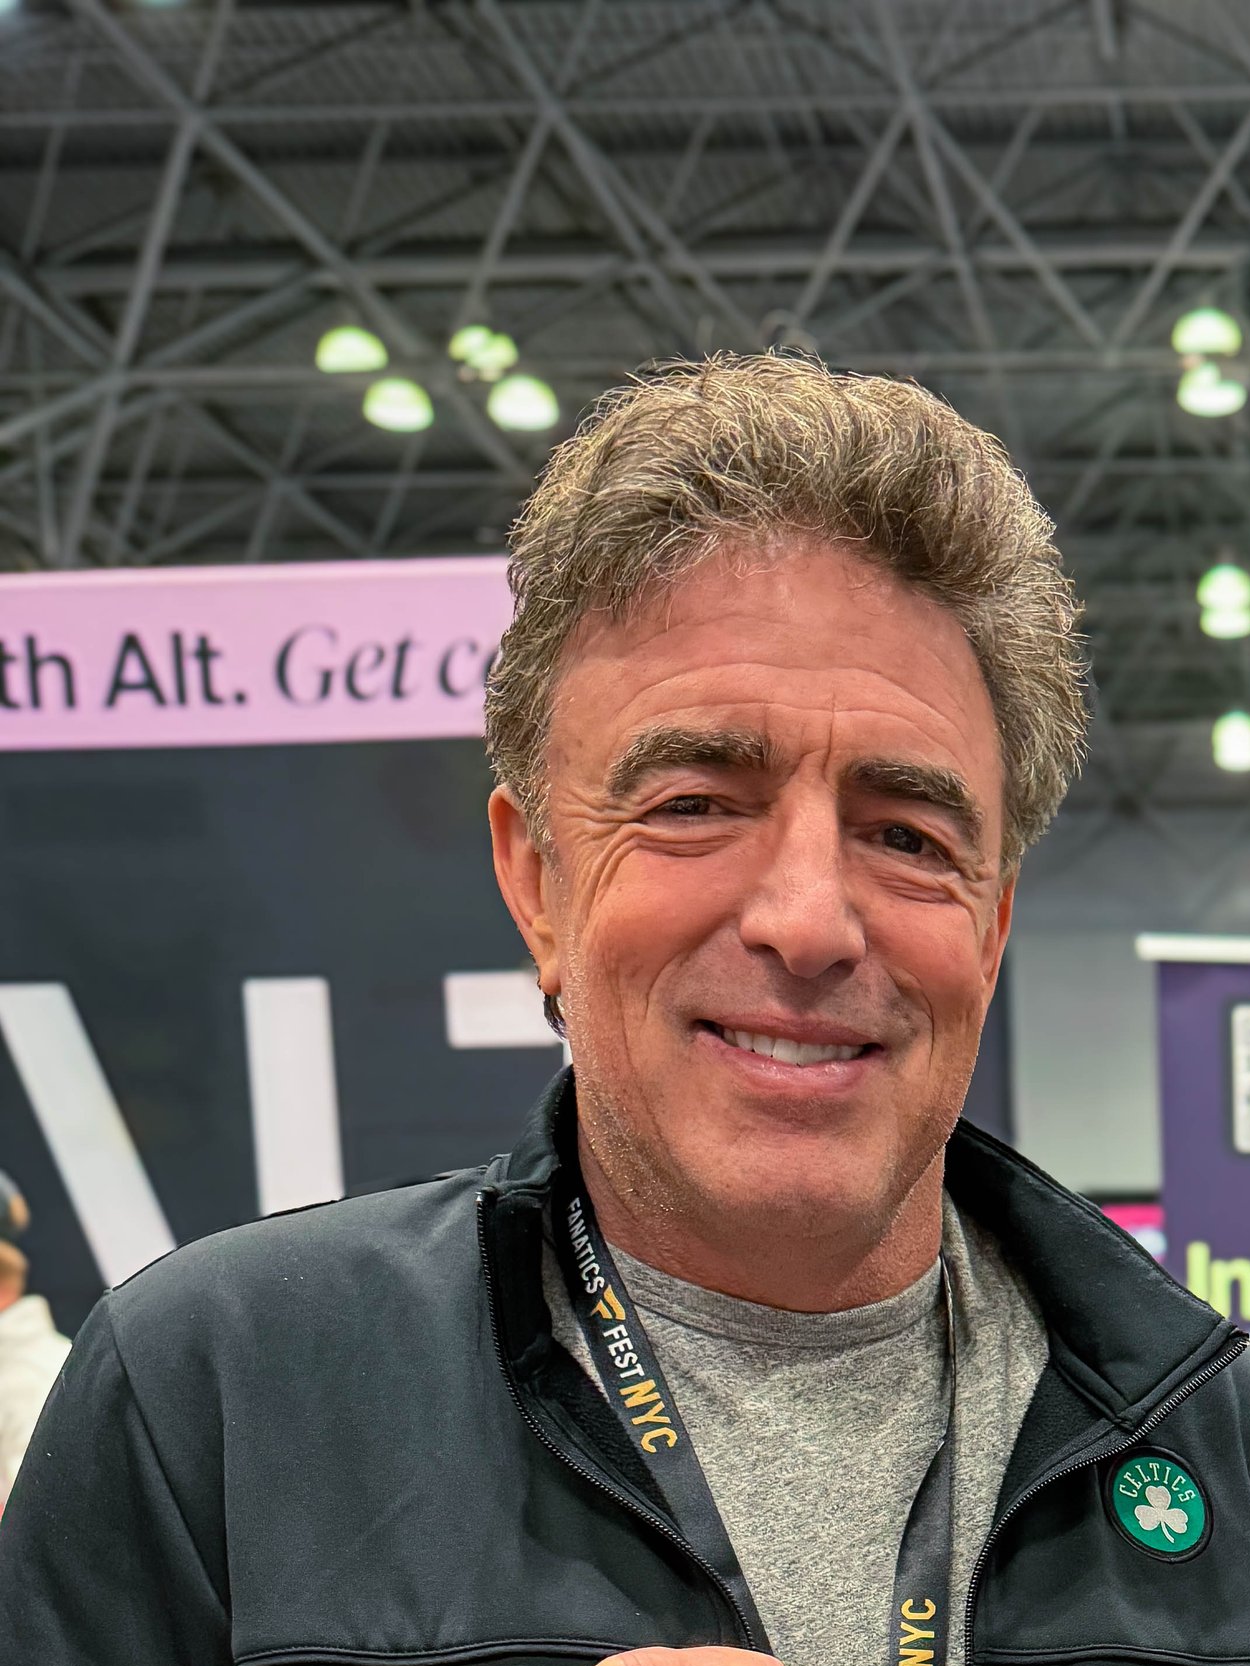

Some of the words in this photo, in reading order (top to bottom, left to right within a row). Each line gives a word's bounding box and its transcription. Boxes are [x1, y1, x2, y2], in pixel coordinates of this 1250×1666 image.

[105, 631, 247, 706] Alt.
[274, 624, 417, 708] Get
[566, 1197, 605, 1294] FANATICS
[603, 1324, 645, 1379] FEST
[619, 1379, 678, 1453] NYC
[1119, 1462, 1197, 1502] CELTICS
